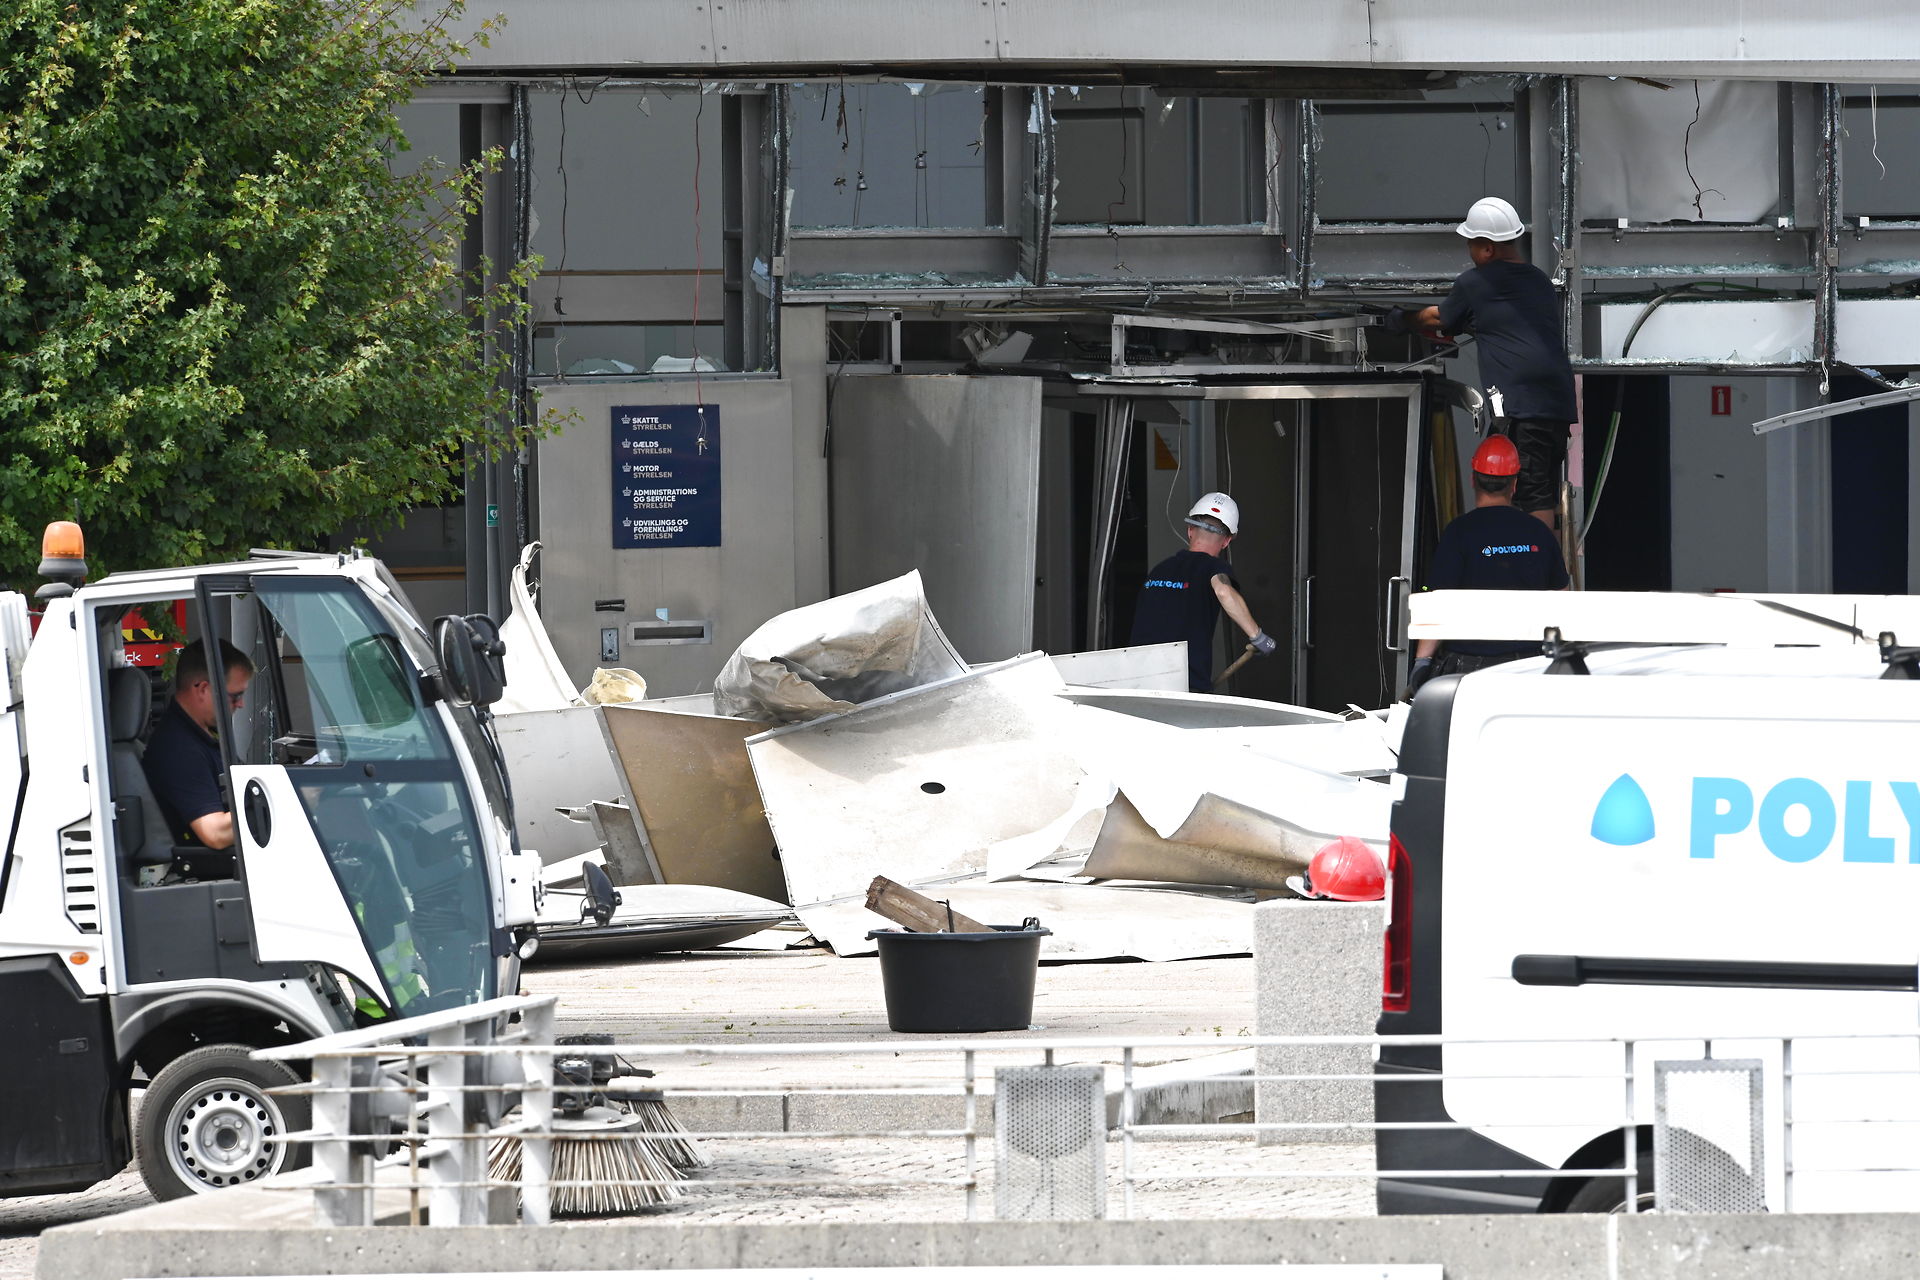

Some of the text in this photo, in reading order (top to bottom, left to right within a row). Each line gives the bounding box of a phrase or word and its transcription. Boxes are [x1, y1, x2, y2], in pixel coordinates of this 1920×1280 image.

[633, 488, 698, 496] ADMINISTRATIONS
[633, 532, 673, 540] STYRELSEN
[1492, 545, 1530, 554] POLYGON
